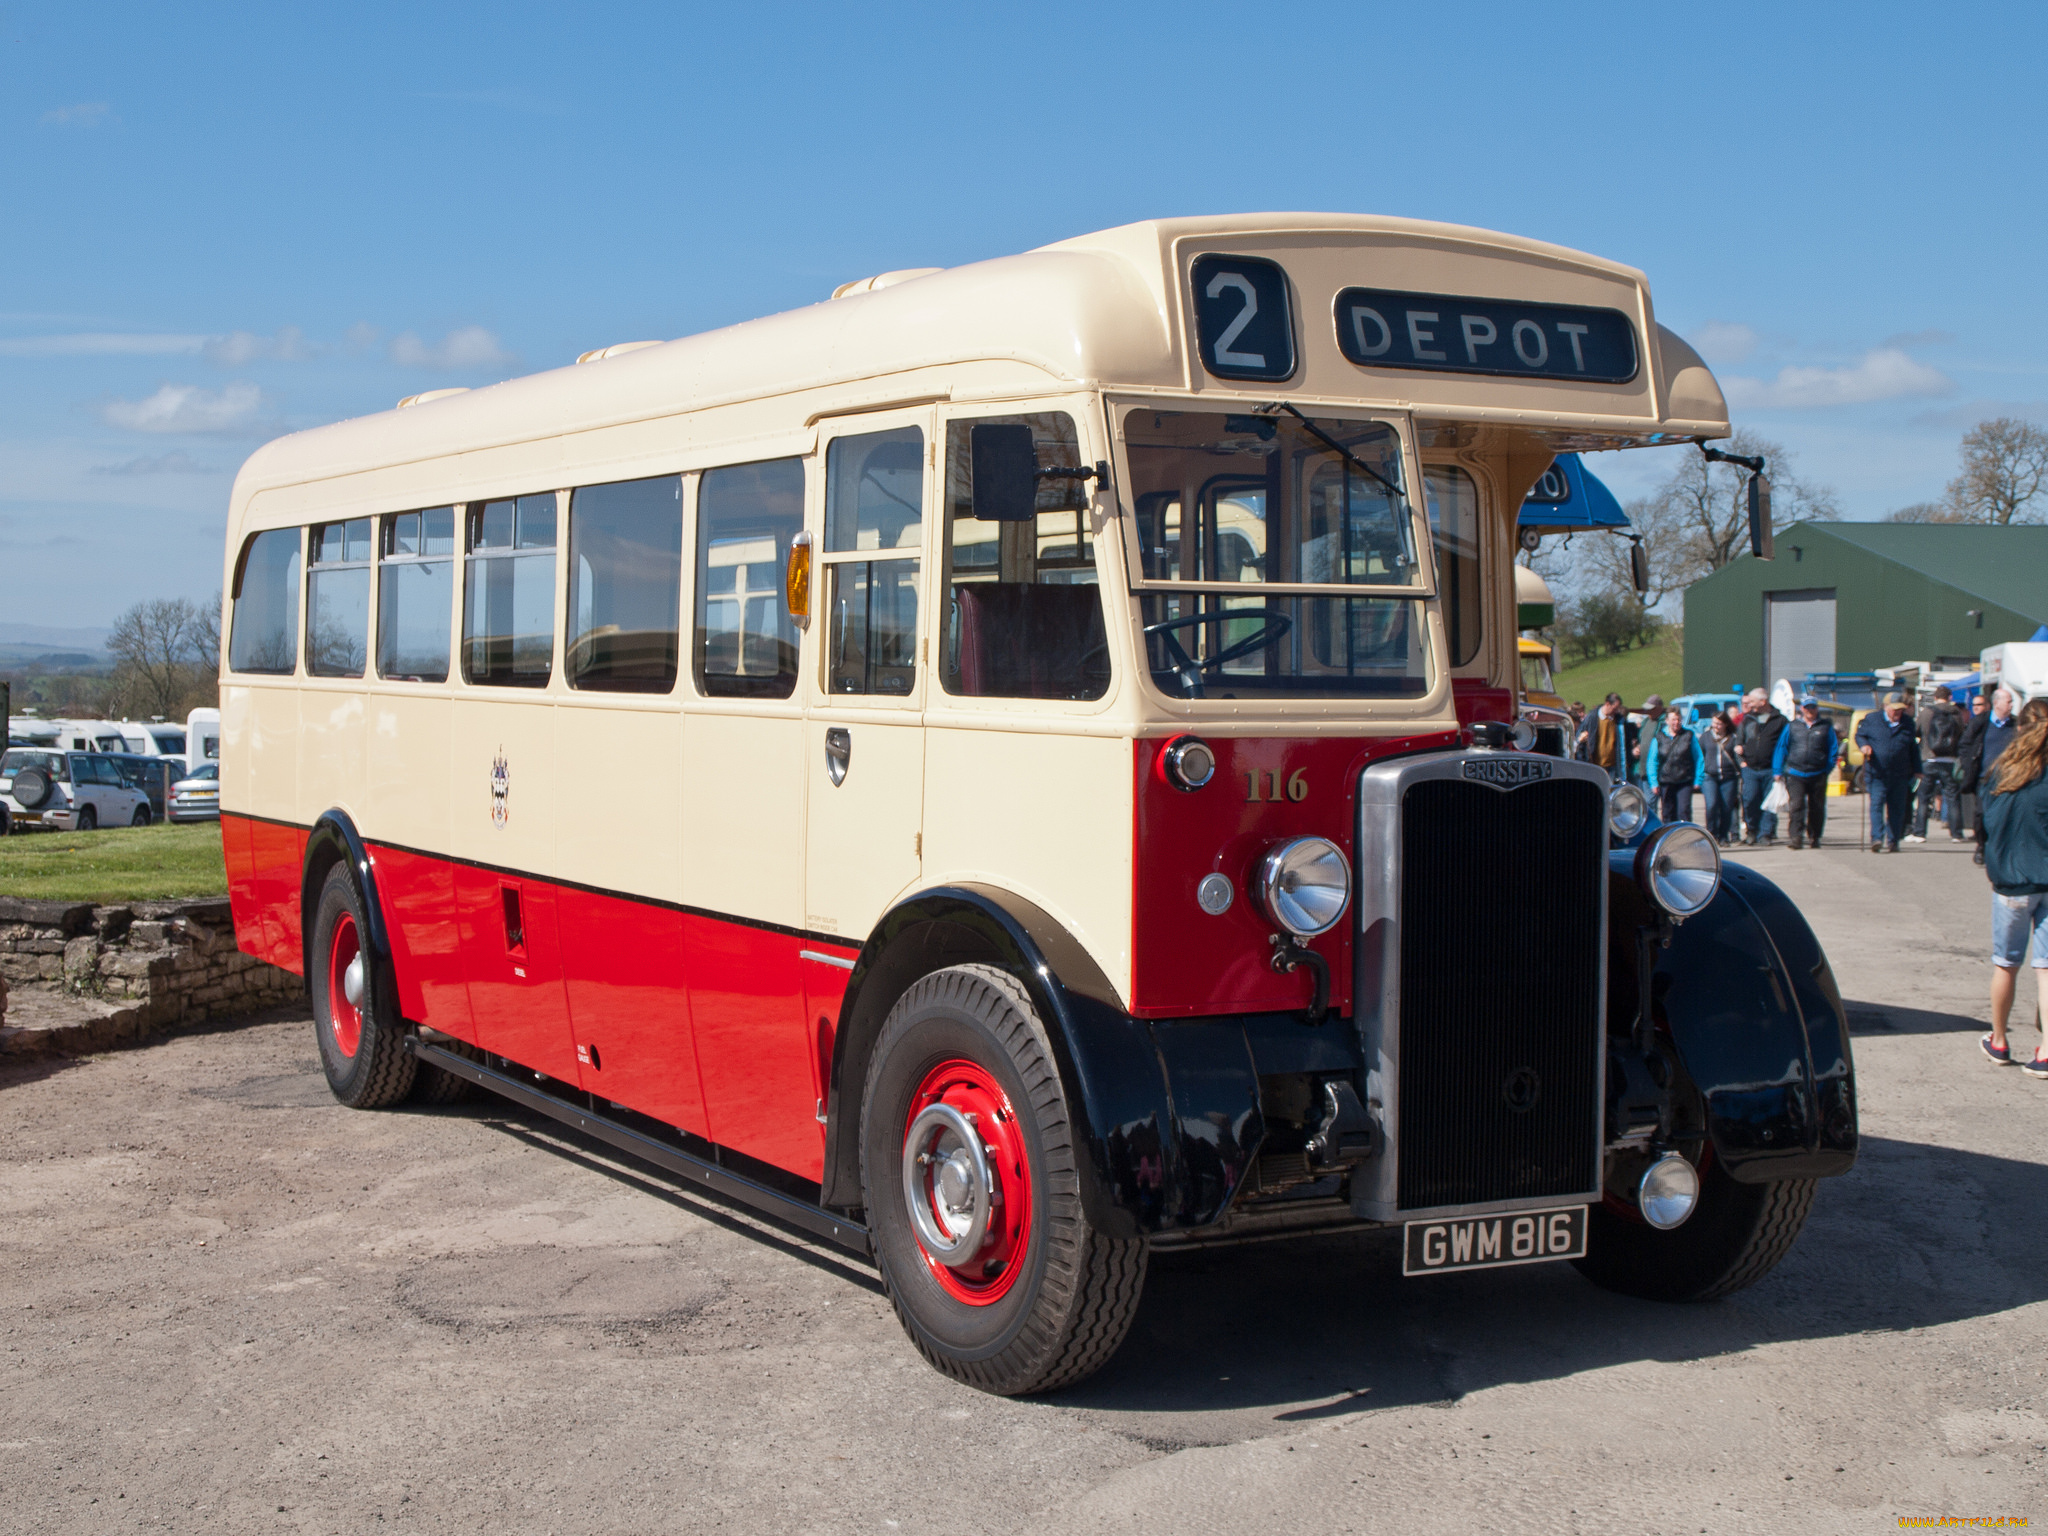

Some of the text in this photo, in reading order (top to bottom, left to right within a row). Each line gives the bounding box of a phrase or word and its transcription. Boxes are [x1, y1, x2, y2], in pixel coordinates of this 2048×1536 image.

[1206, 272, 1266, 367] 2
[1351, 305, 1589, 371] DEPOT
[1243, 766, 1309, 803] 116
[1465, 760, 1549, 782] CROSSLEY
[1423, 1213, 1571, 1266] GWM 816
